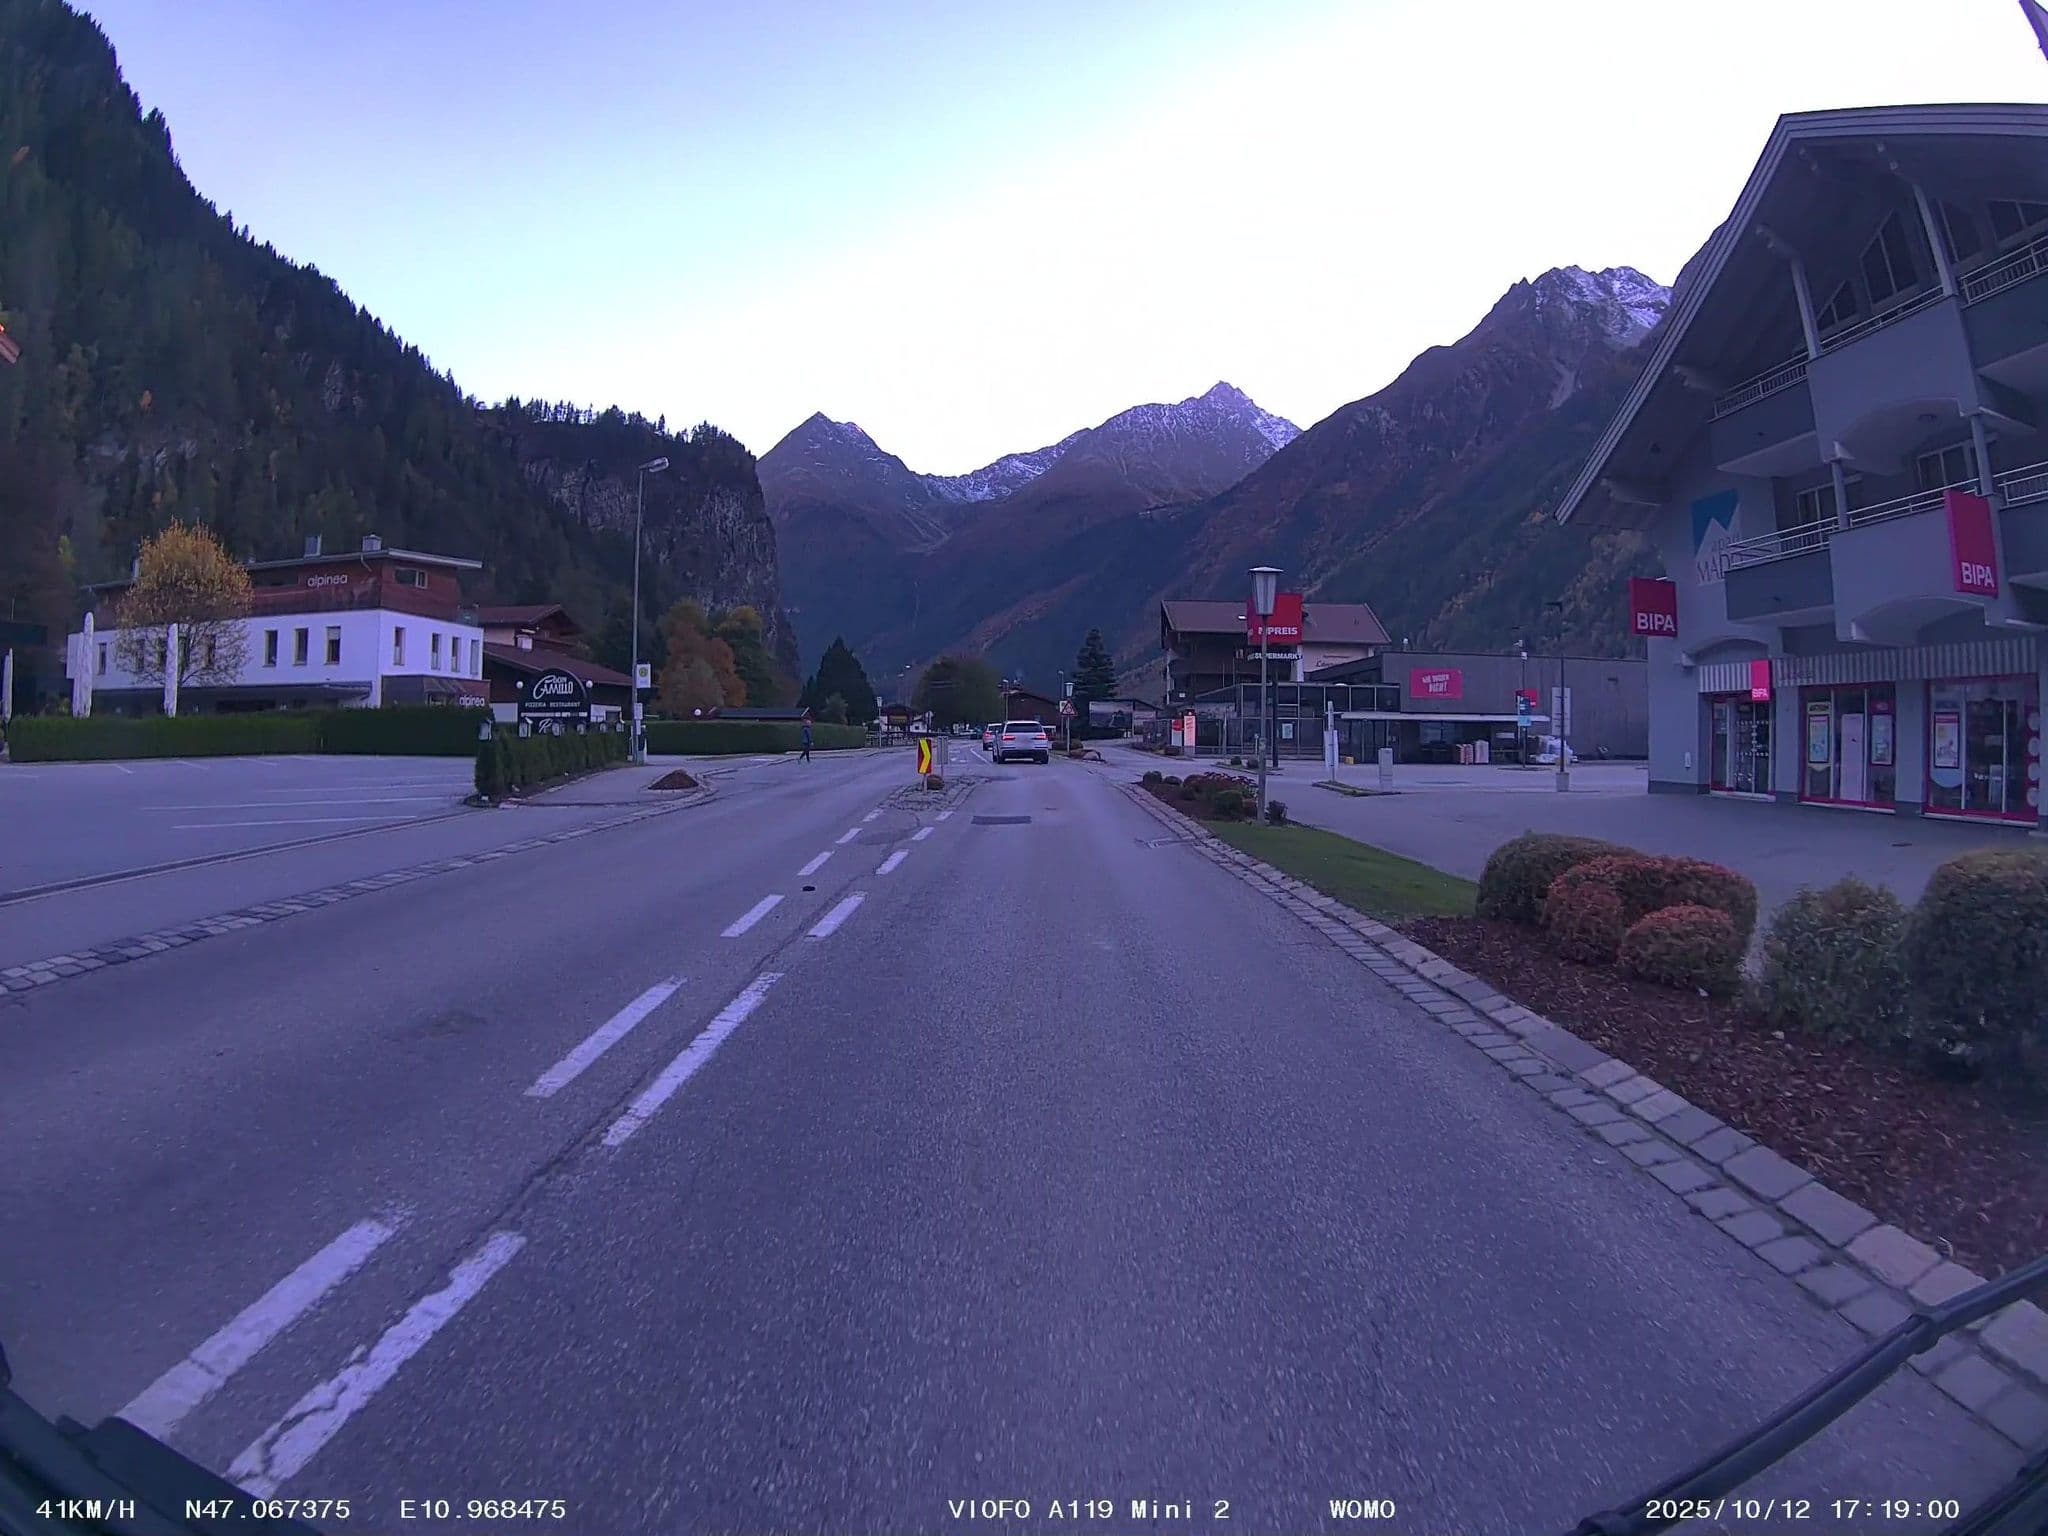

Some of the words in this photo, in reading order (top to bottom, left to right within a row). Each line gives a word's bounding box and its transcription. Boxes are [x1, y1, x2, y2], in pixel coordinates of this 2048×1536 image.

[307, 574, 348, 589] alpinea
[1961, 561, 1995, 588] BIPA
[1636, 612, 1676, 632] BIPA
[532, 674, 574, 699] CAMILLO
[1751, 687, 1769, 698] BIPA
